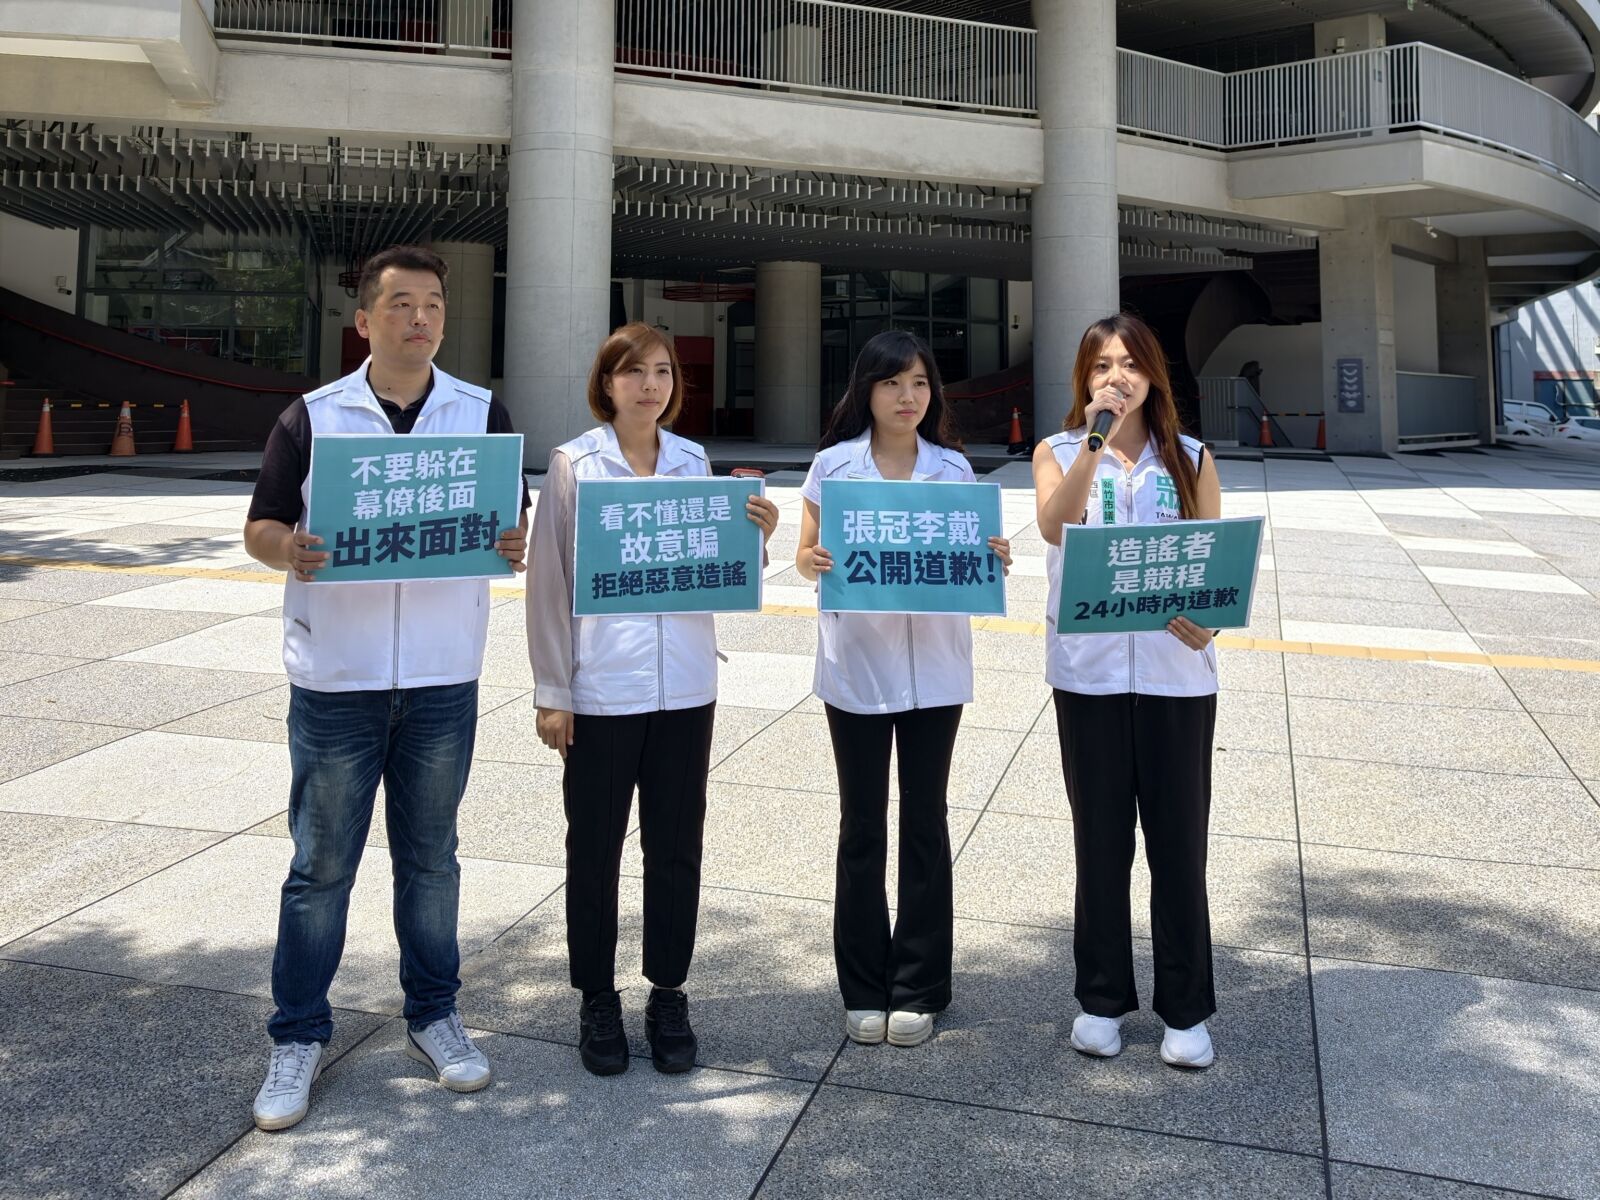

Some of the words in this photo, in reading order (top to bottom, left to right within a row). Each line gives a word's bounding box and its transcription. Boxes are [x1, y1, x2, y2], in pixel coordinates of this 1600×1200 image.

[350, 447, 477, 485] 不要躲在
[352, 480, 477, 520] 幕僚後面
[600, 495, 732, 531] 看不懂還是
[1156, 512, 1178, 520] TAIWA
[332, 511, 500, 568] 出來面對
[620, 526, 719, 565] 故意騙
[842, 510, 981, 546] 張冠李戴
[1107, 531, 1216, 567] 造謠者
[592, 560, 747, 599] 拒絕惡意造謠
[843, 550, 996, 586] 公開道歉!
[1110, 562, 1206, 595] 是競程
[1074, 586, 1239, 620] 24小時內道歉
